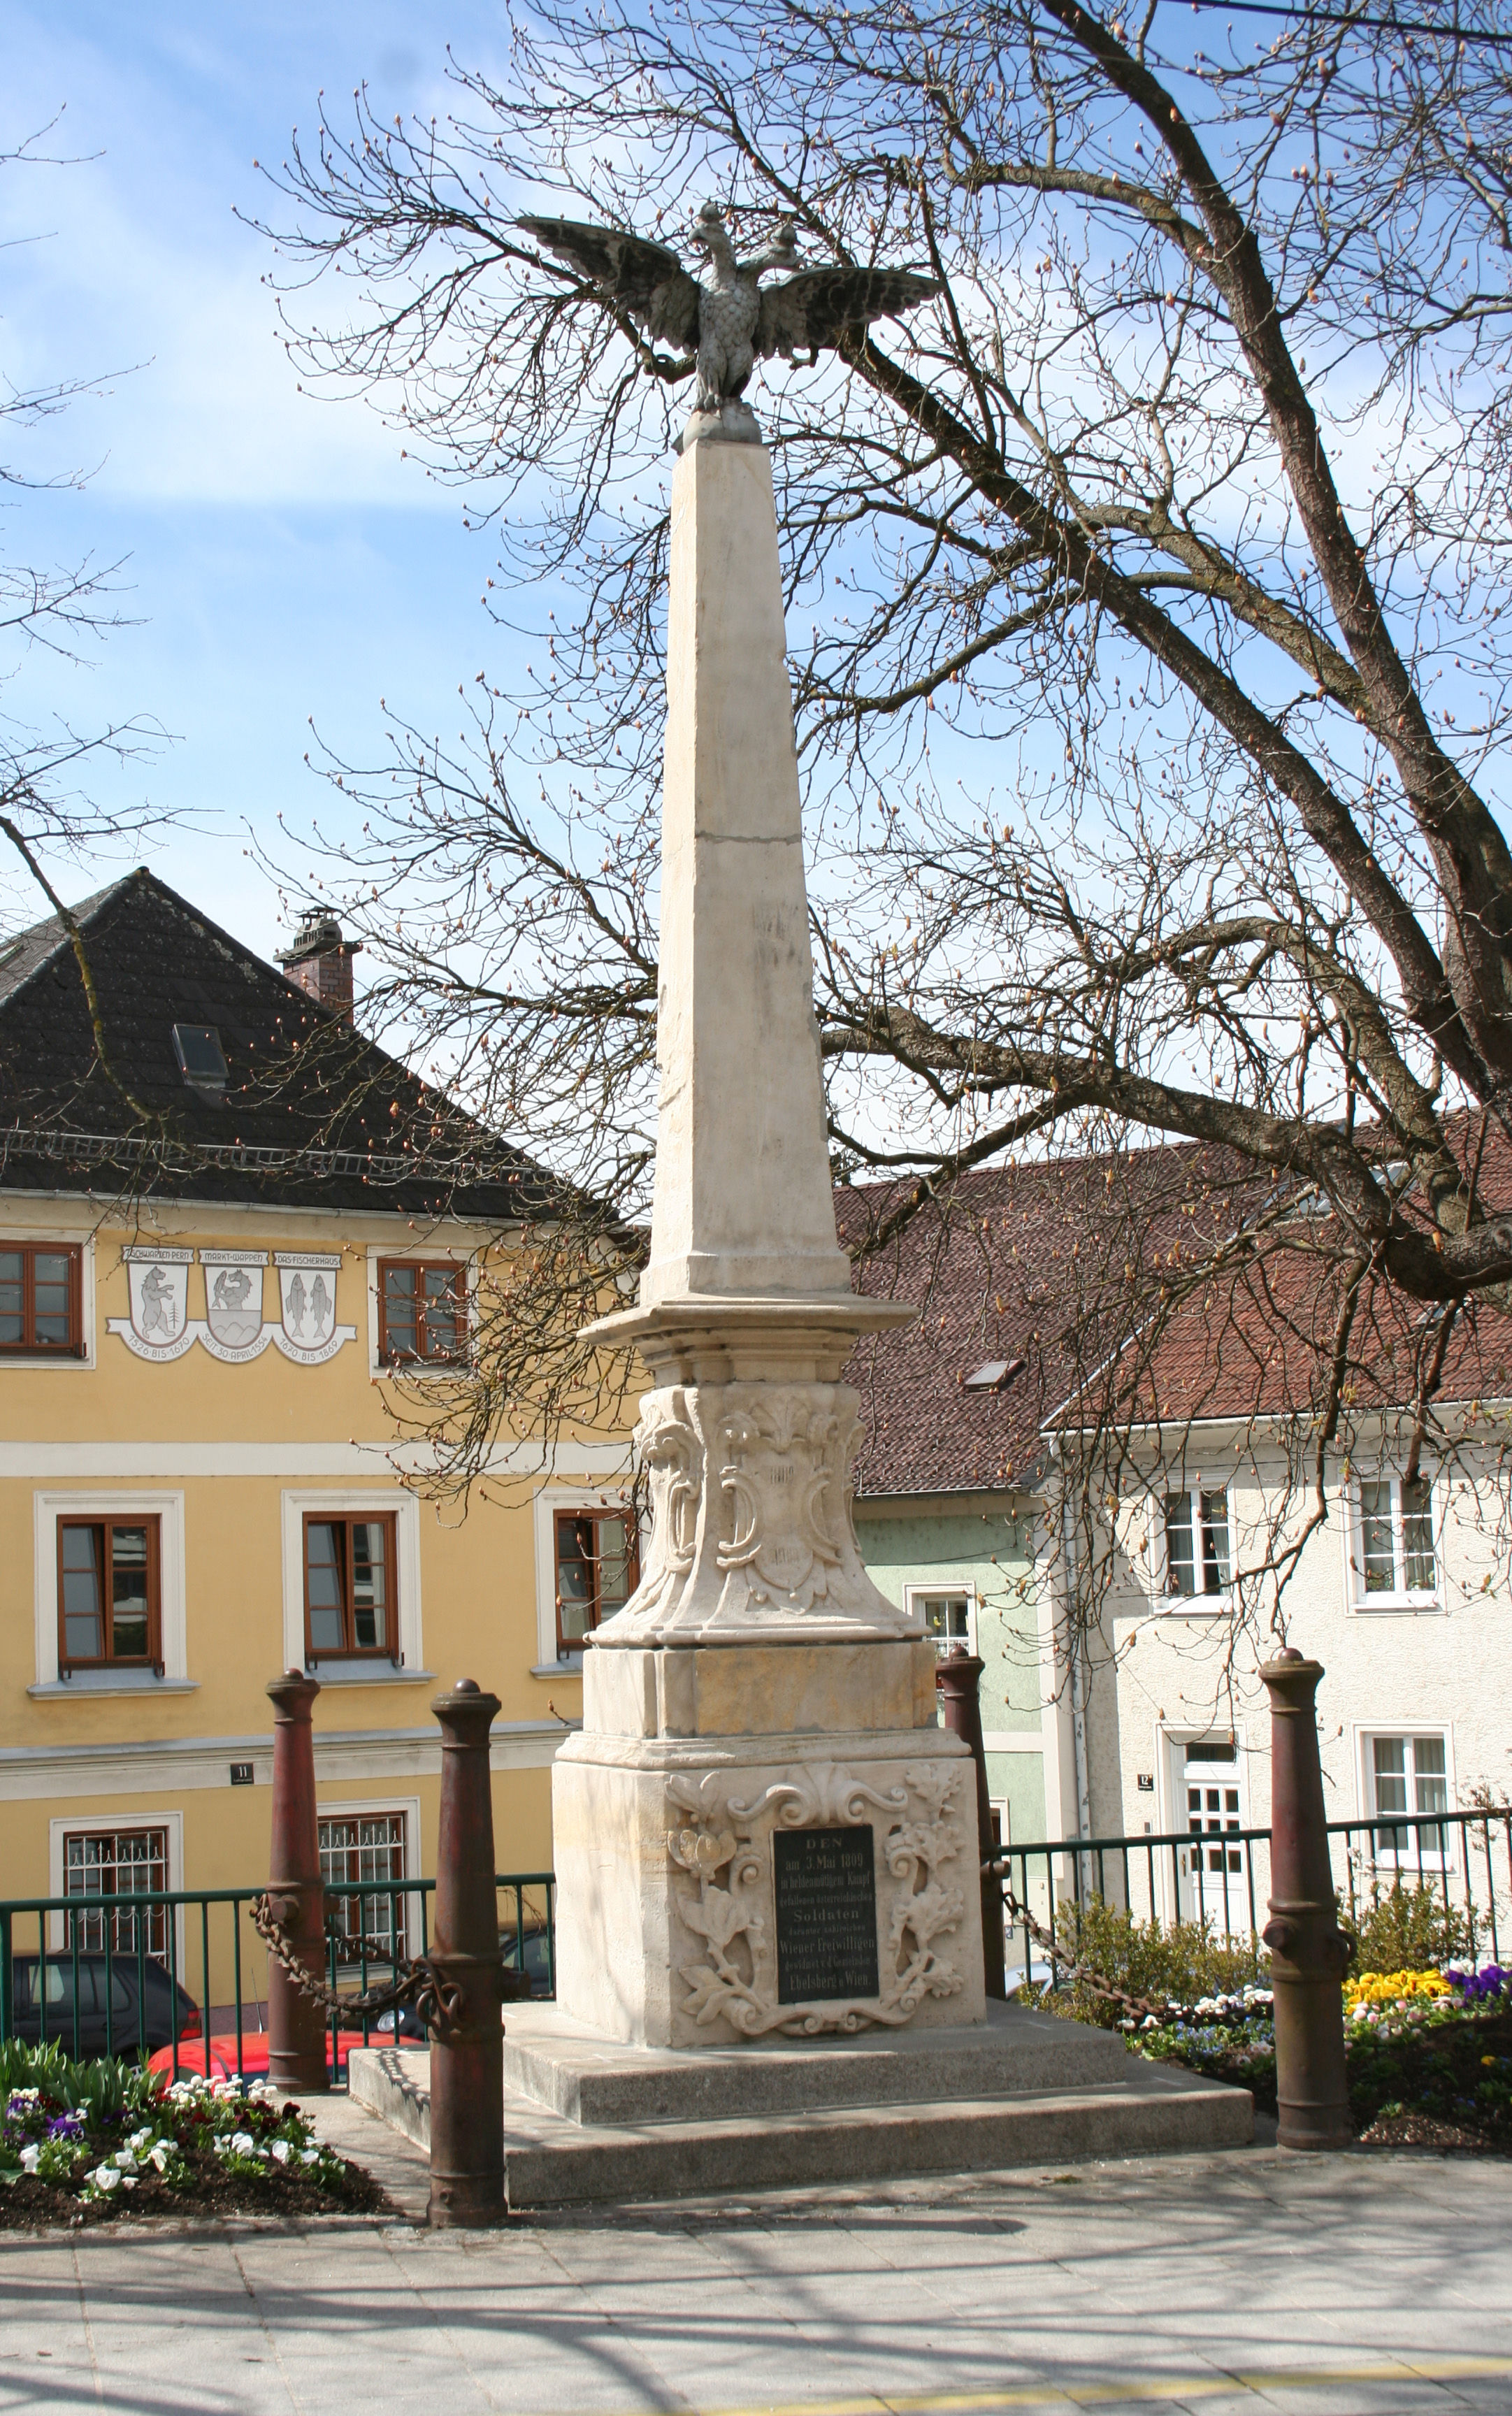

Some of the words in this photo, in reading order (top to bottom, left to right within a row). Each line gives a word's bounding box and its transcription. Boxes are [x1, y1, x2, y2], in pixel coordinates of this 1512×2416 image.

[301, 1352, 316, 1361] BIS
[238, 1766, 246, 1777] 11
[1142, 1775, 1148, 1784] 12
[807, 1838, 842, 1849] DEN
[785, 1860, 800, 1871] am
[841, 1852, 863, 1868] 1809
[794, 1908, 859, 1922] Soldaten
[780, 1939, 815, 1954] Wiener
[818, 1936, 874, 1952] Freiwilligen
